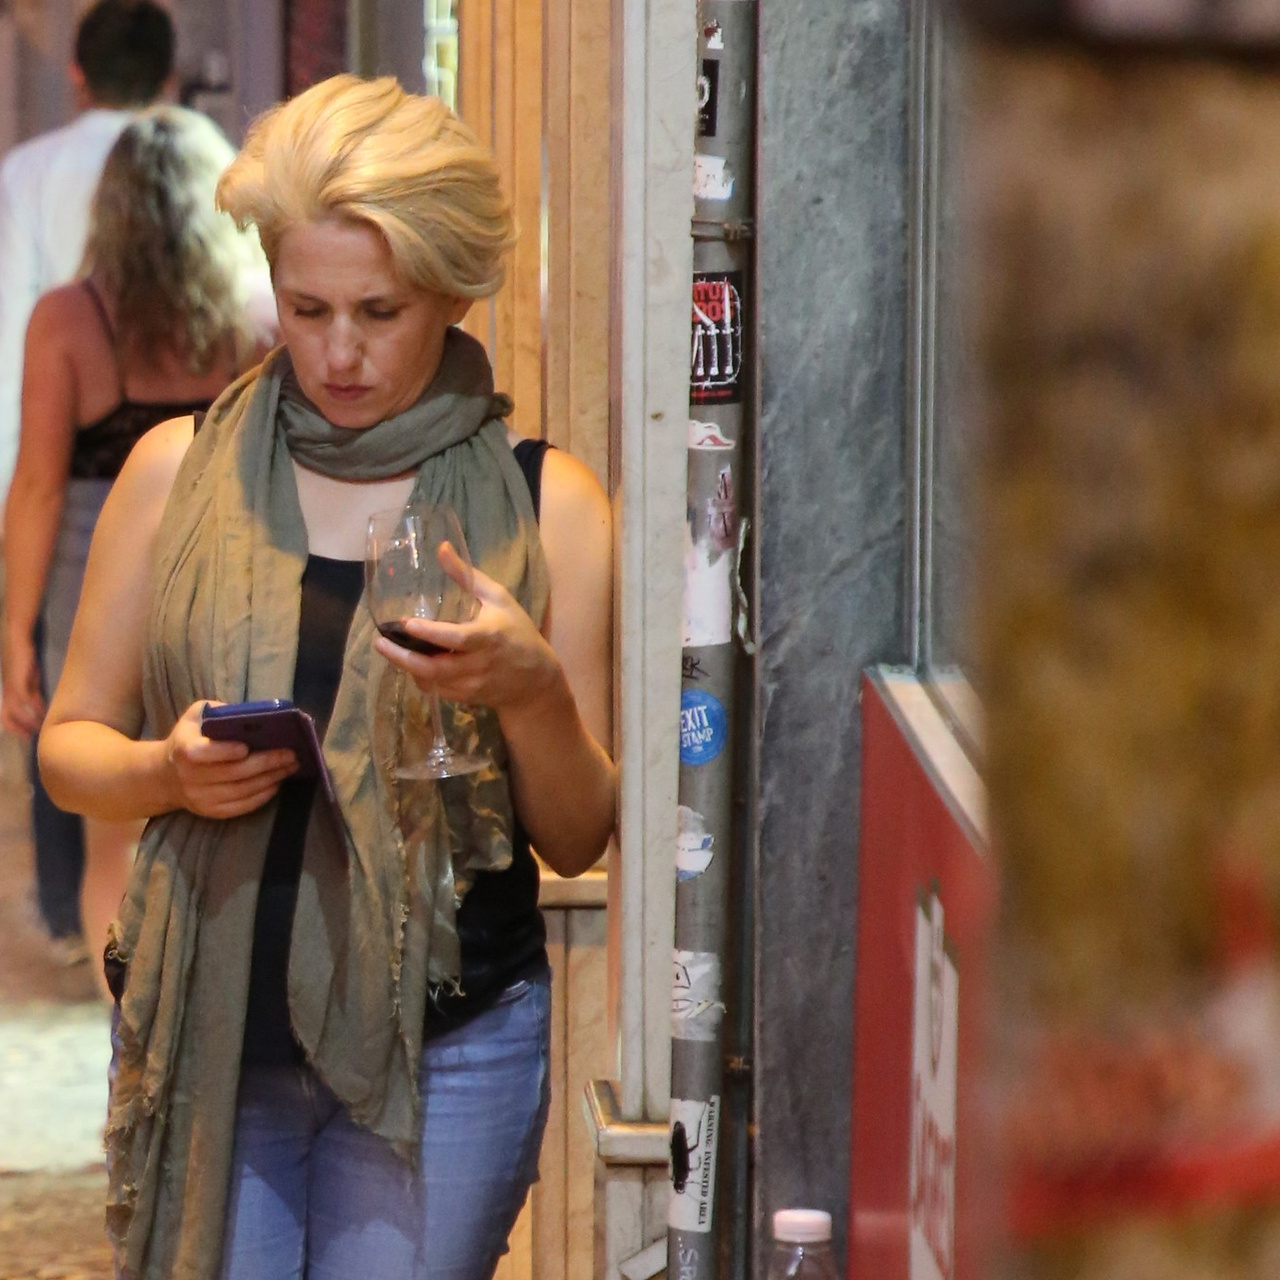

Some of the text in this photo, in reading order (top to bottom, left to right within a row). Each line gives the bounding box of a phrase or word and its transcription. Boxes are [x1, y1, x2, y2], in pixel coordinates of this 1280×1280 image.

[680, 706, 709, 732] EXIT
[681, 726, 714, 748] STAMP
[698, 1101, 716, 1226] WARNING: INFESTED AREA
